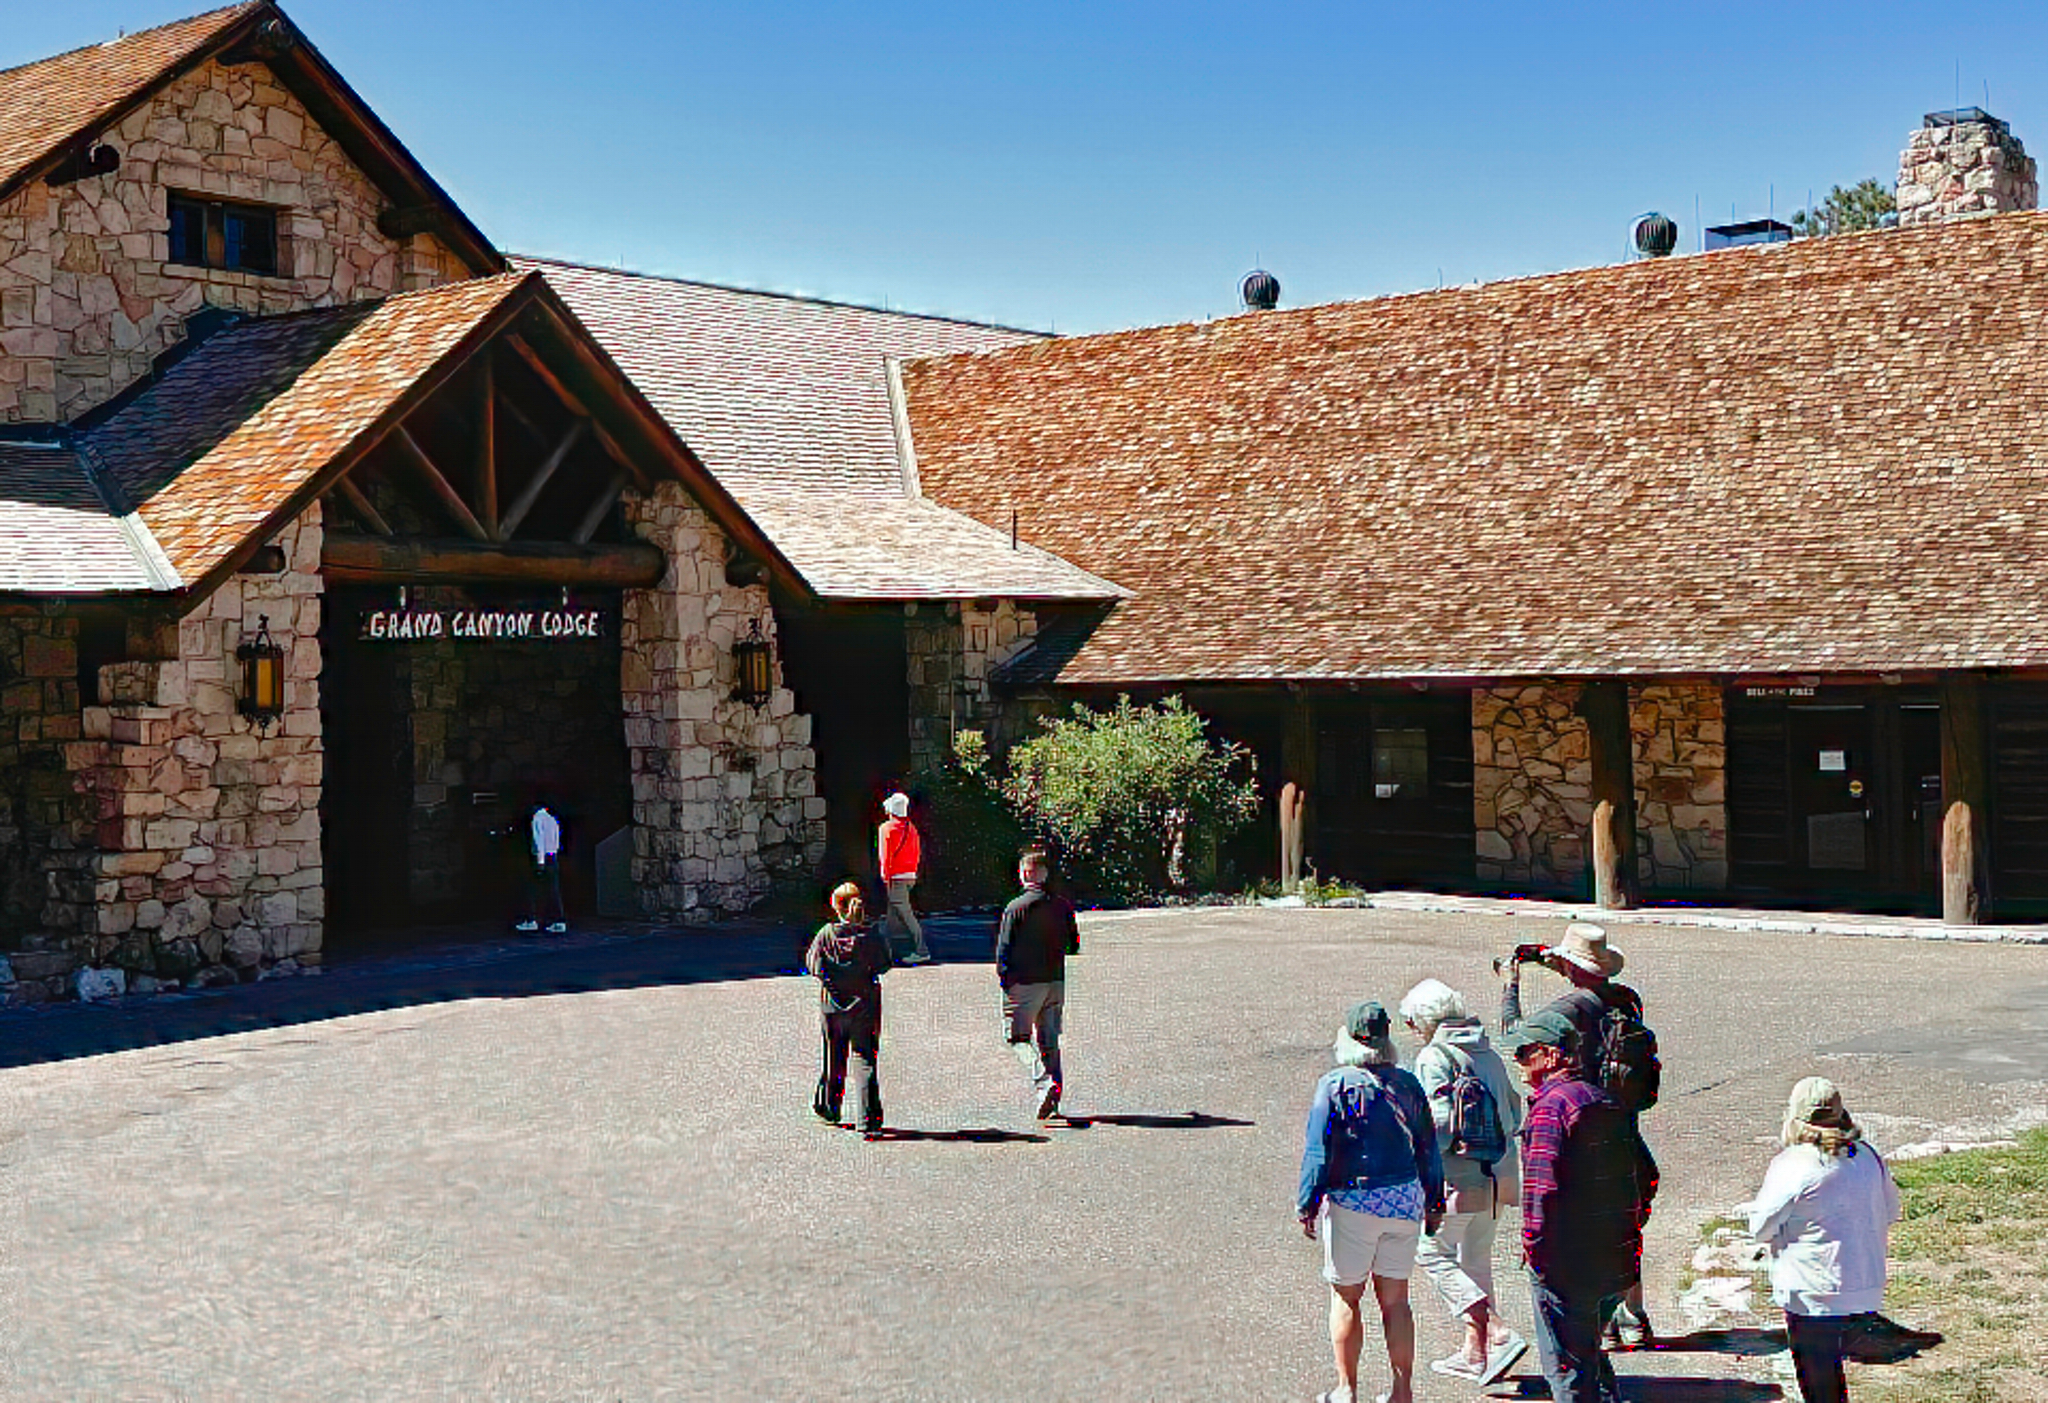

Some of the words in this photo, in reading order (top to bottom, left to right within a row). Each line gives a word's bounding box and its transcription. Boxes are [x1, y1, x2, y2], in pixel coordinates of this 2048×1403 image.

[370, 611, 443, 638] GRAND
[452, 611, 534, 637] CANYON
[541, 611, 599, 637] LODGE
